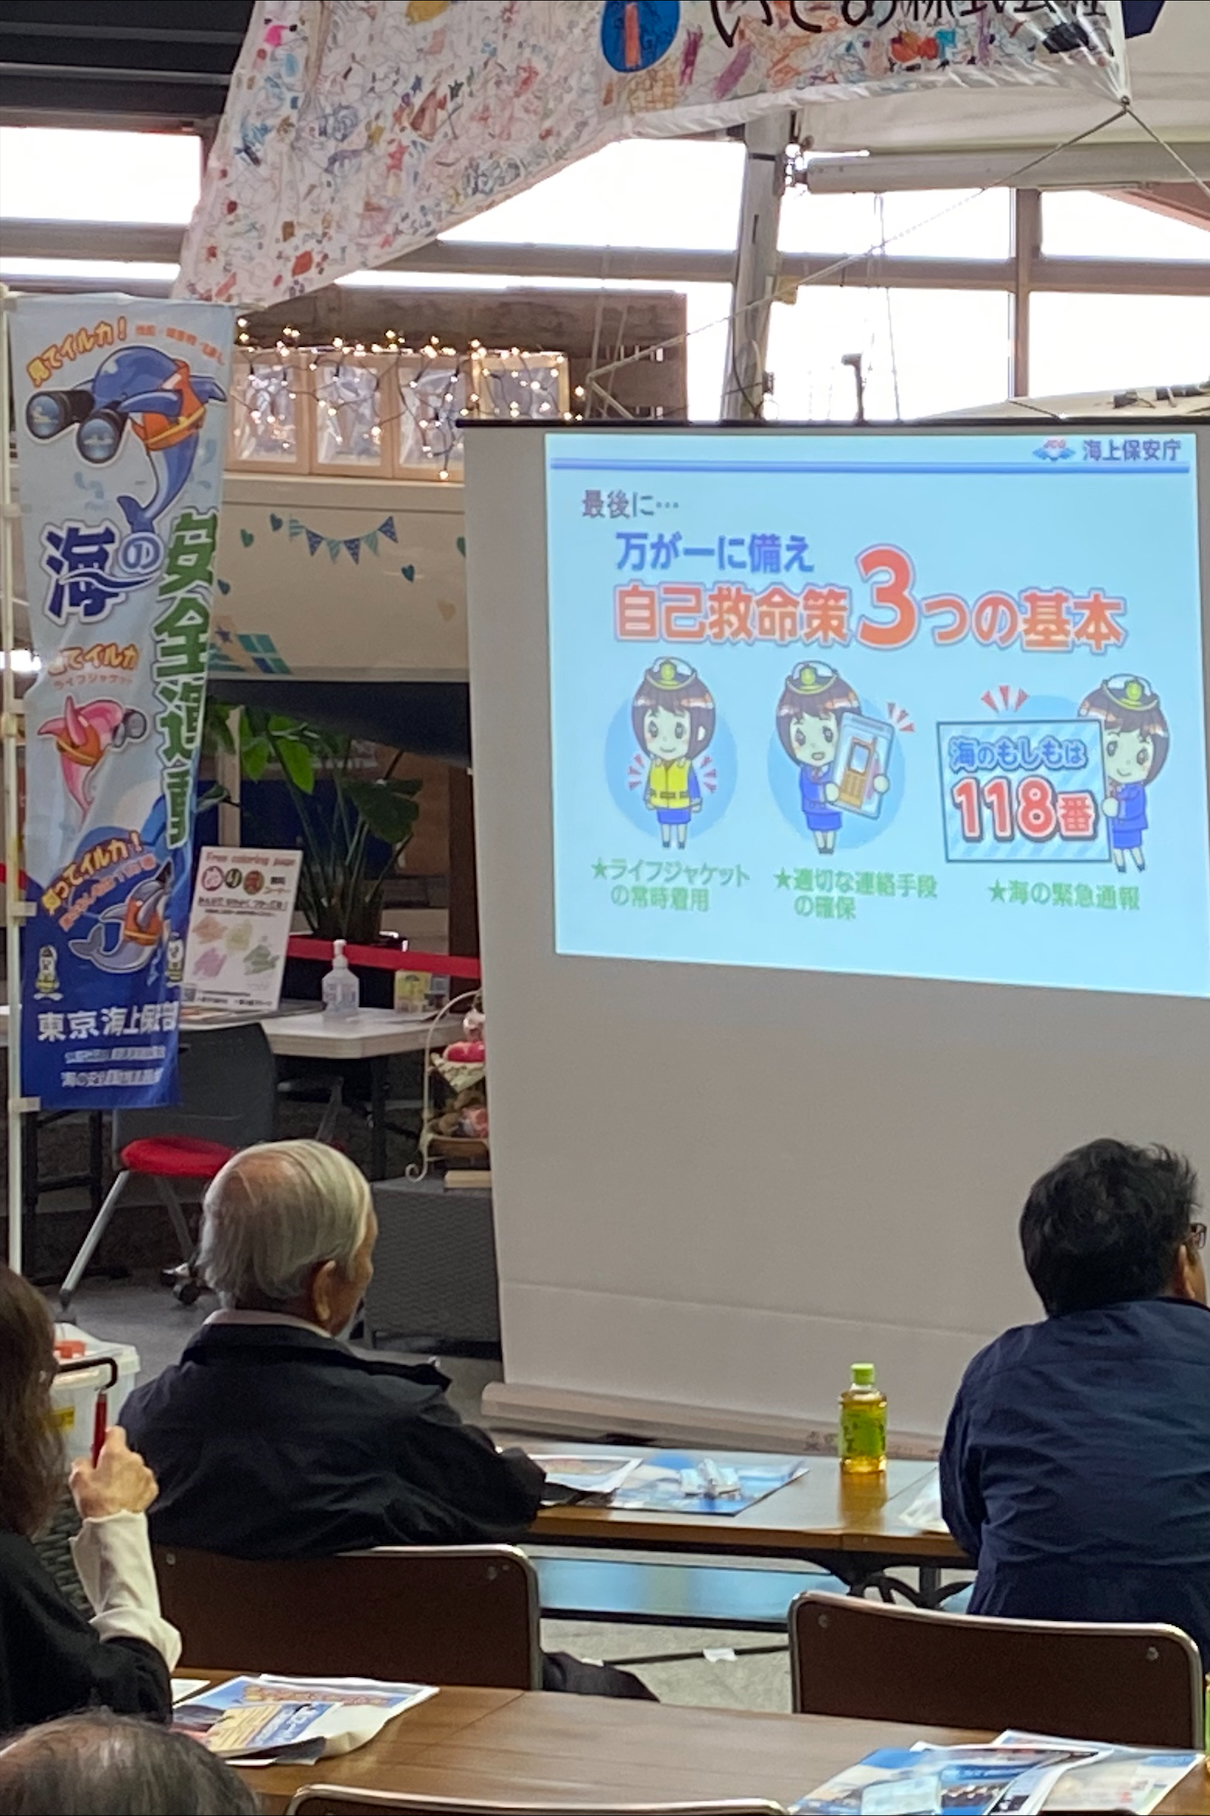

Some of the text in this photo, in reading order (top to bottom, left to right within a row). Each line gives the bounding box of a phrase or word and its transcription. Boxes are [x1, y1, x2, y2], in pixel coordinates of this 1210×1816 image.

[1083, 438, 1181, 461] 海上保安庁
[615, 531, 814, 574] 万が一に備え
[950, 735, 1088, 773] 海のもしもは
[953, 775, 1098, 842] 118番
[610, 884, 710, 913] の常時着用
[794, 895, 857, 920] の確保
